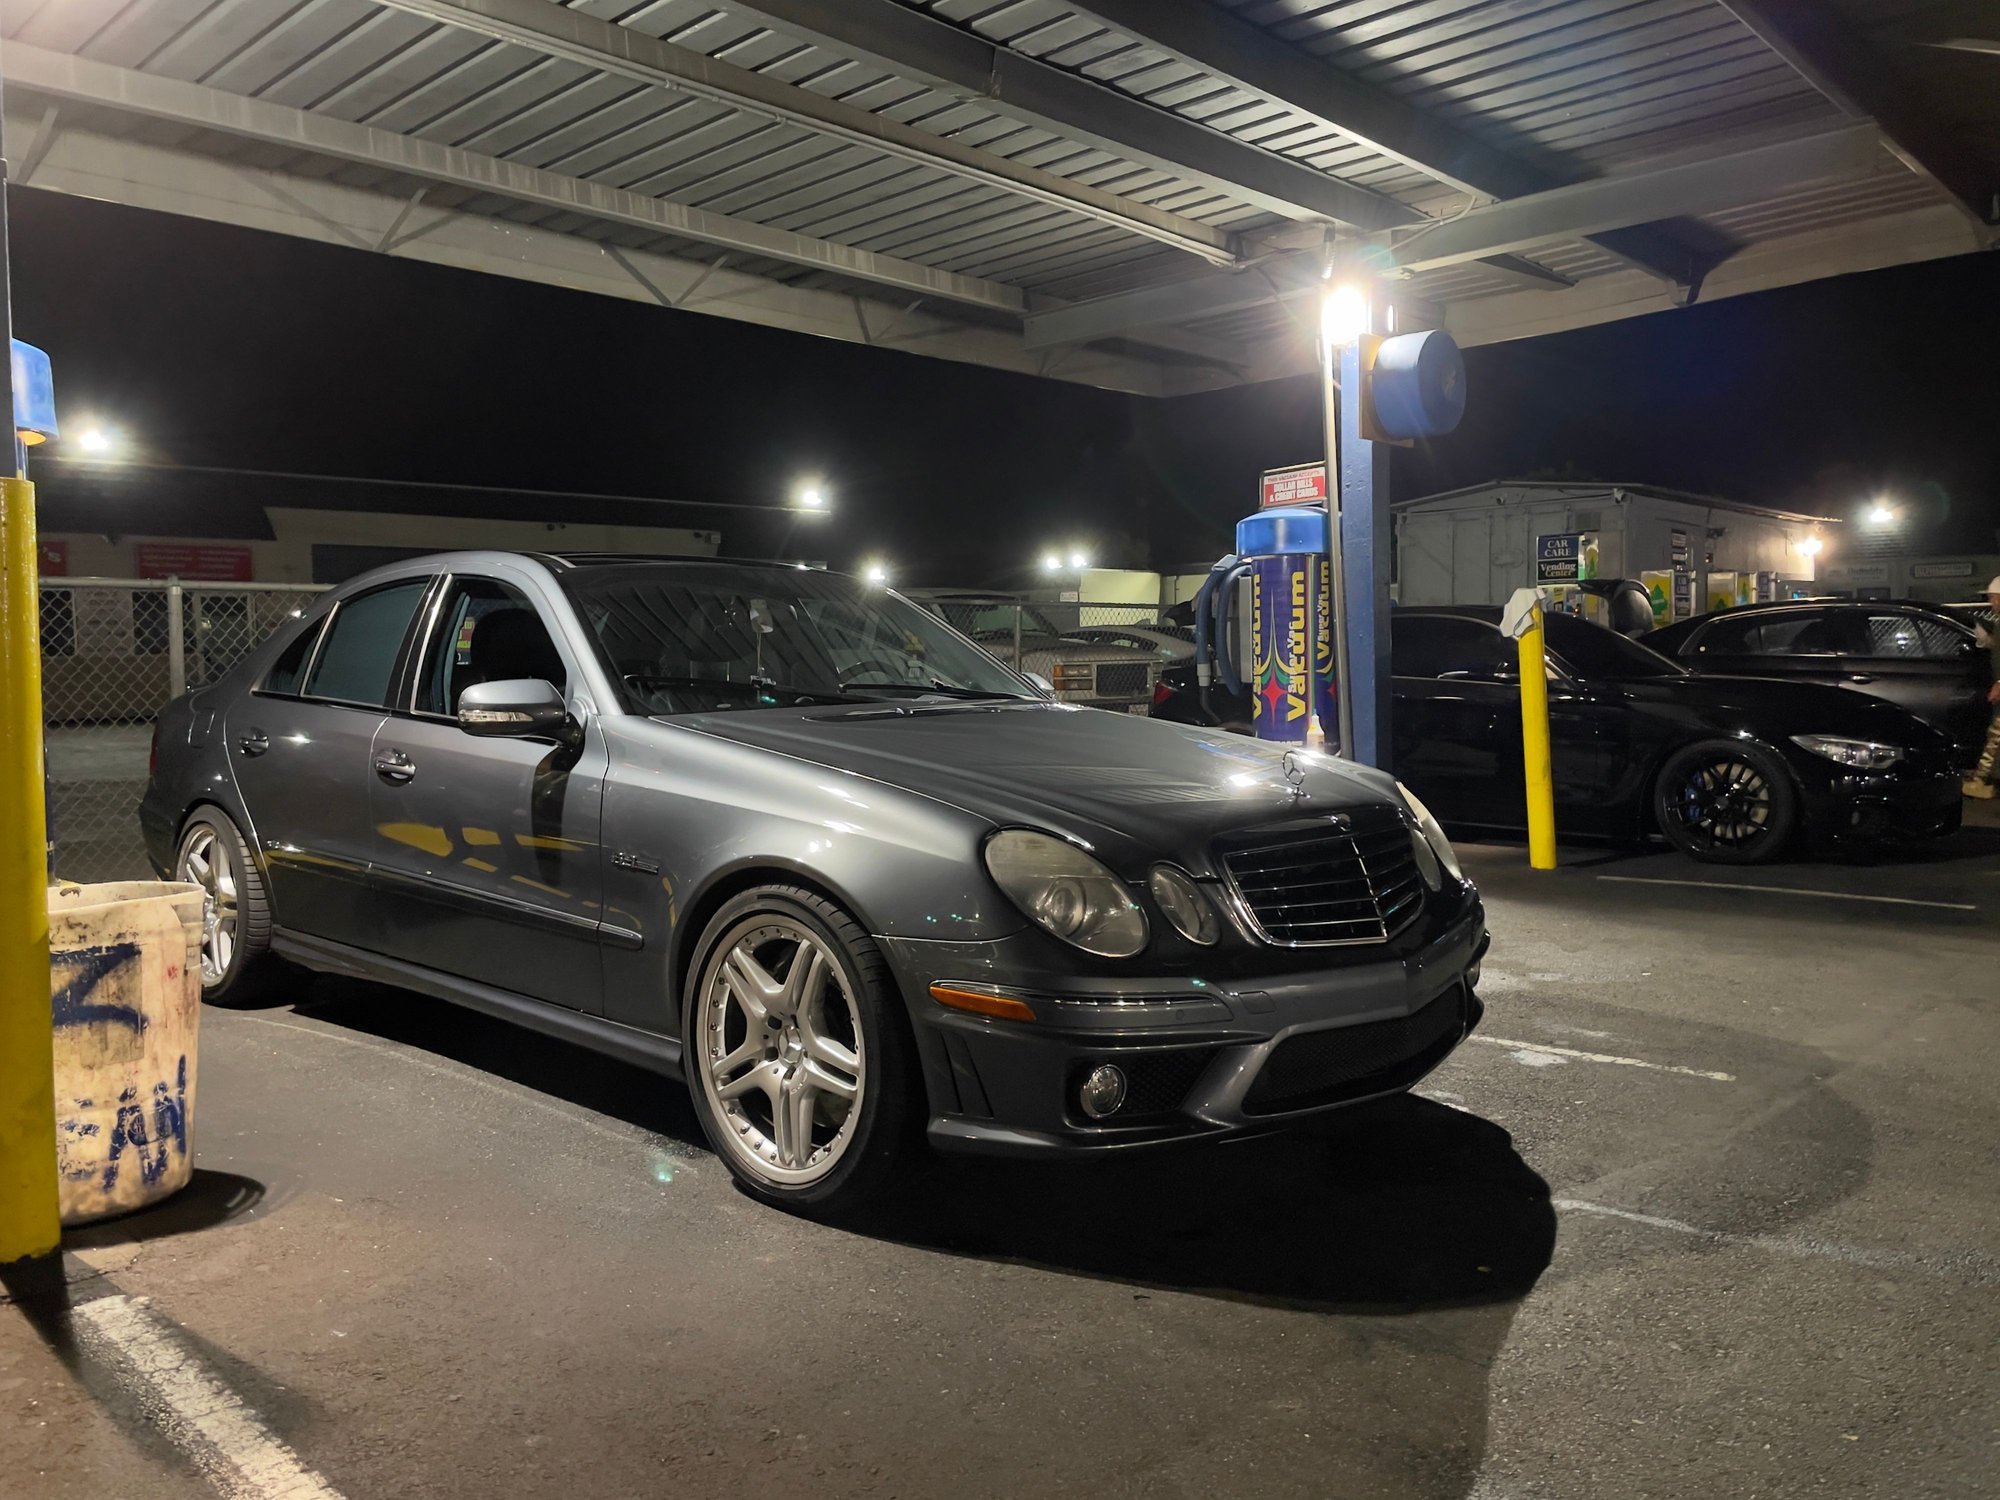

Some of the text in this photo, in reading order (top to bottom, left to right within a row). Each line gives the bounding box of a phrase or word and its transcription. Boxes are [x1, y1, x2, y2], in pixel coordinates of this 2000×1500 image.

[1274, 481, 1296, 492] DOLLAR
[1547, 539, 1568, 549] CAR
[1544, 548, 1570, 557] CARE
[1540, 562, 1576, 572] Vending
[1316, 561, 1330, 660] Vacuum
[1286, 571, 1306, 722] Vacuum
